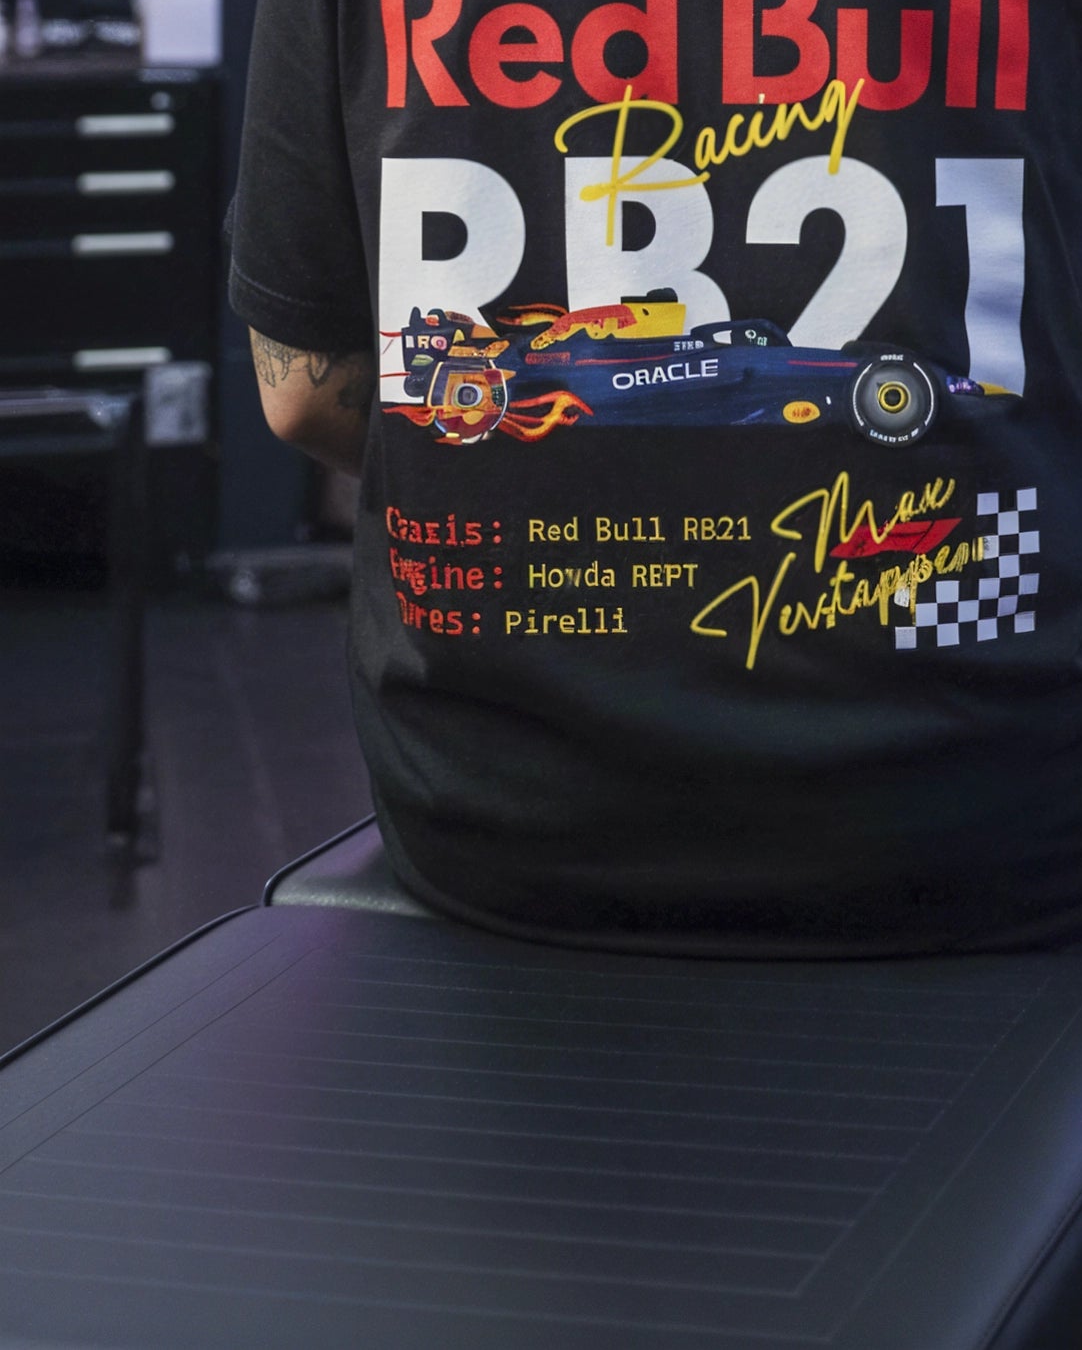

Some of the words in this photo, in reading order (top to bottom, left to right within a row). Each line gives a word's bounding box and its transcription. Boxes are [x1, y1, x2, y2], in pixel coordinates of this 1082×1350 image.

[554, 78, 865, 247] Racing
[378, 155, 1025, 404] RB21
[612, 358, 719, 390] ORACLE
[528, 516, 580, 543] Red
[595, 516, 666, 543] Bull
[683, 516, 752, 542] RB21
[505, 607, 629, 635] Pirelli
